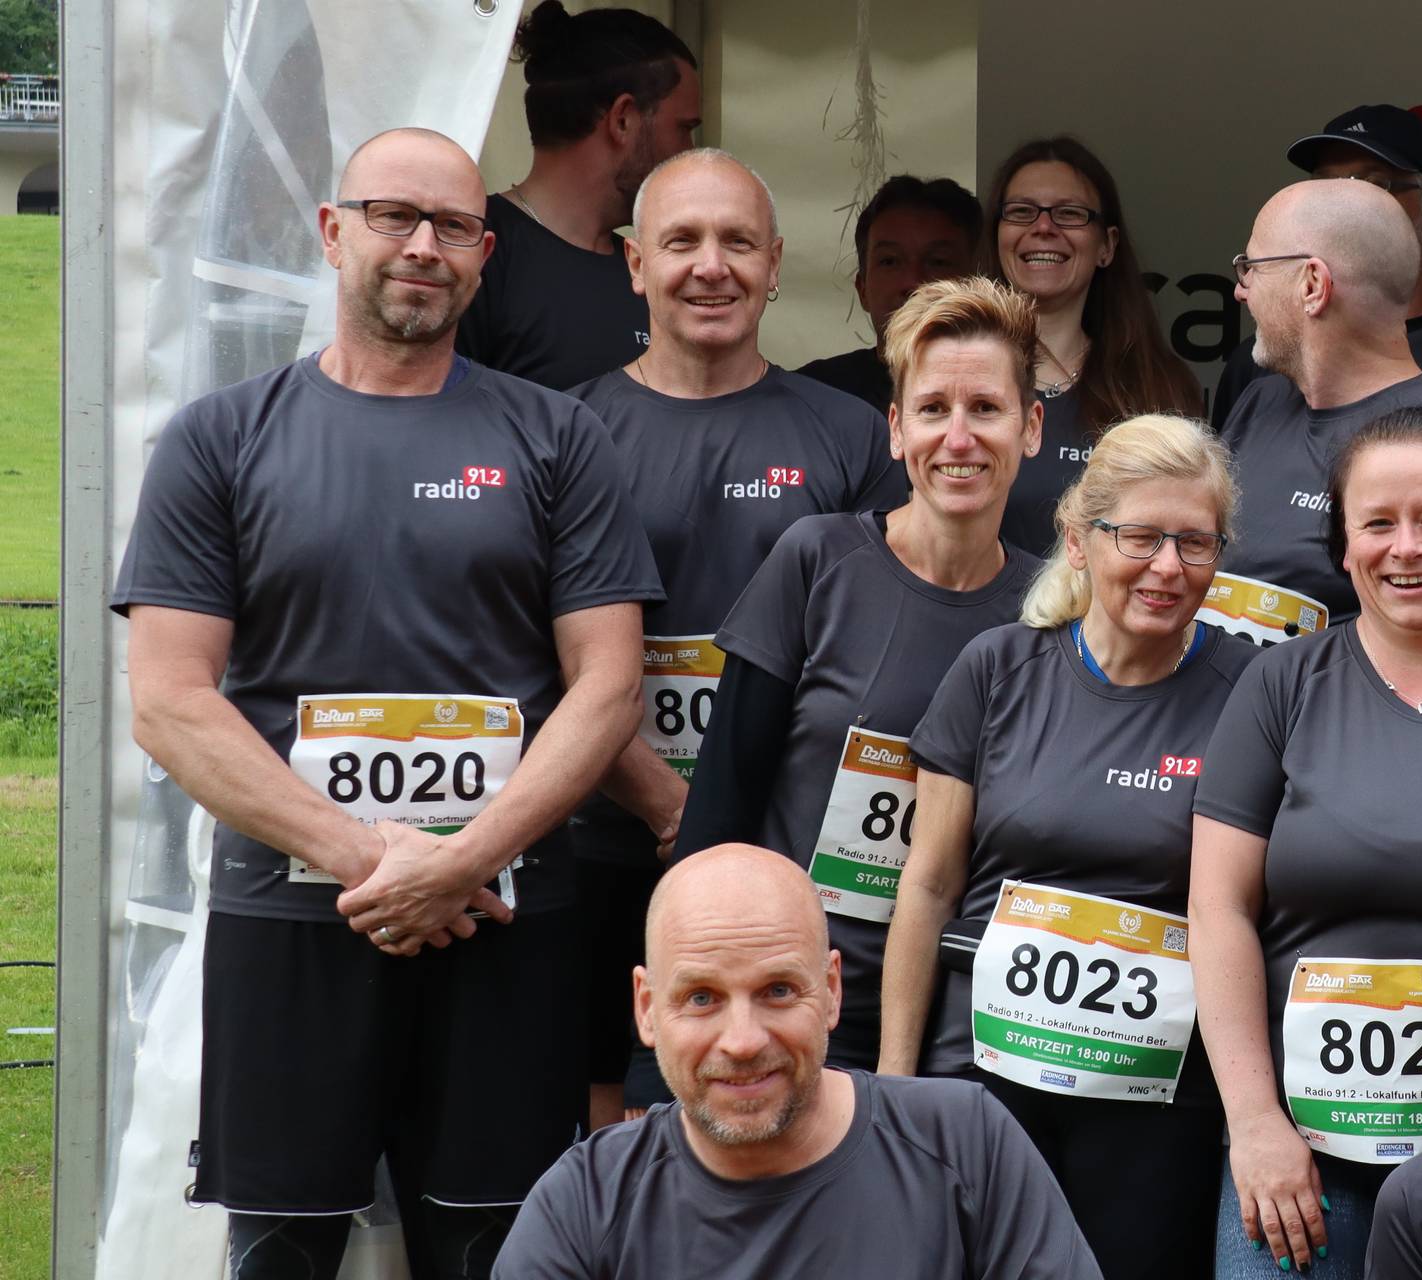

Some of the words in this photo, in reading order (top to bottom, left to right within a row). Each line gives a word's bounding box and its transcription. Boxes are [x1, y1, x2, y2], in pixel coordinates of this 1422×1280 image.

[1059, 446, 1093, 462] rad
[468, 467, 501, 485] 91.2
[771, 468, 799, 485] 91.2
[414, 478, 480, 500] radio
[724, 479, 781, 499] radio
[670, 748, 688, 756] 91.2
[860, 744, 904, 765] B2Run
[1165, 757, 1198, 775] 91.2
[328, 751, 485, 804] 8020
[1106, 768, 1173, 792] radio
[837, 847, 865, 860] Radio
[867, 853, 887, 865] 91.2
[856, 872, 900, 889] START
[1005, 943, 1158, 1020] 8023
[987, 1003, 1012, 1018] Radio
[1013, 1010, 1033, 1022] 91.2
[1041, 1017, 1090, 1034] Lokalfunk
[1092, 1027, 1144, 1043] Dortmund
[1146, 1035, 1168, 1047] Betr
[1005, 1031, 1074, 1057] STARTZEIT
[1076, 1047, 1111, 1063] 18:00
[1113, 1053, 1137, 1066] Uhr
[1128, 1084, 1150, 1095] XING
[1305, 1086, 1333, 1097] Radio
[1335, 1088, 1356, 1098] 91.2
[1366, 1089, 1417, 1100] Lokalfunk
[1331, 1111, 1404, 1125] STARTZEIT
[1378, 1143, 1406, 1151] ERDINGER
